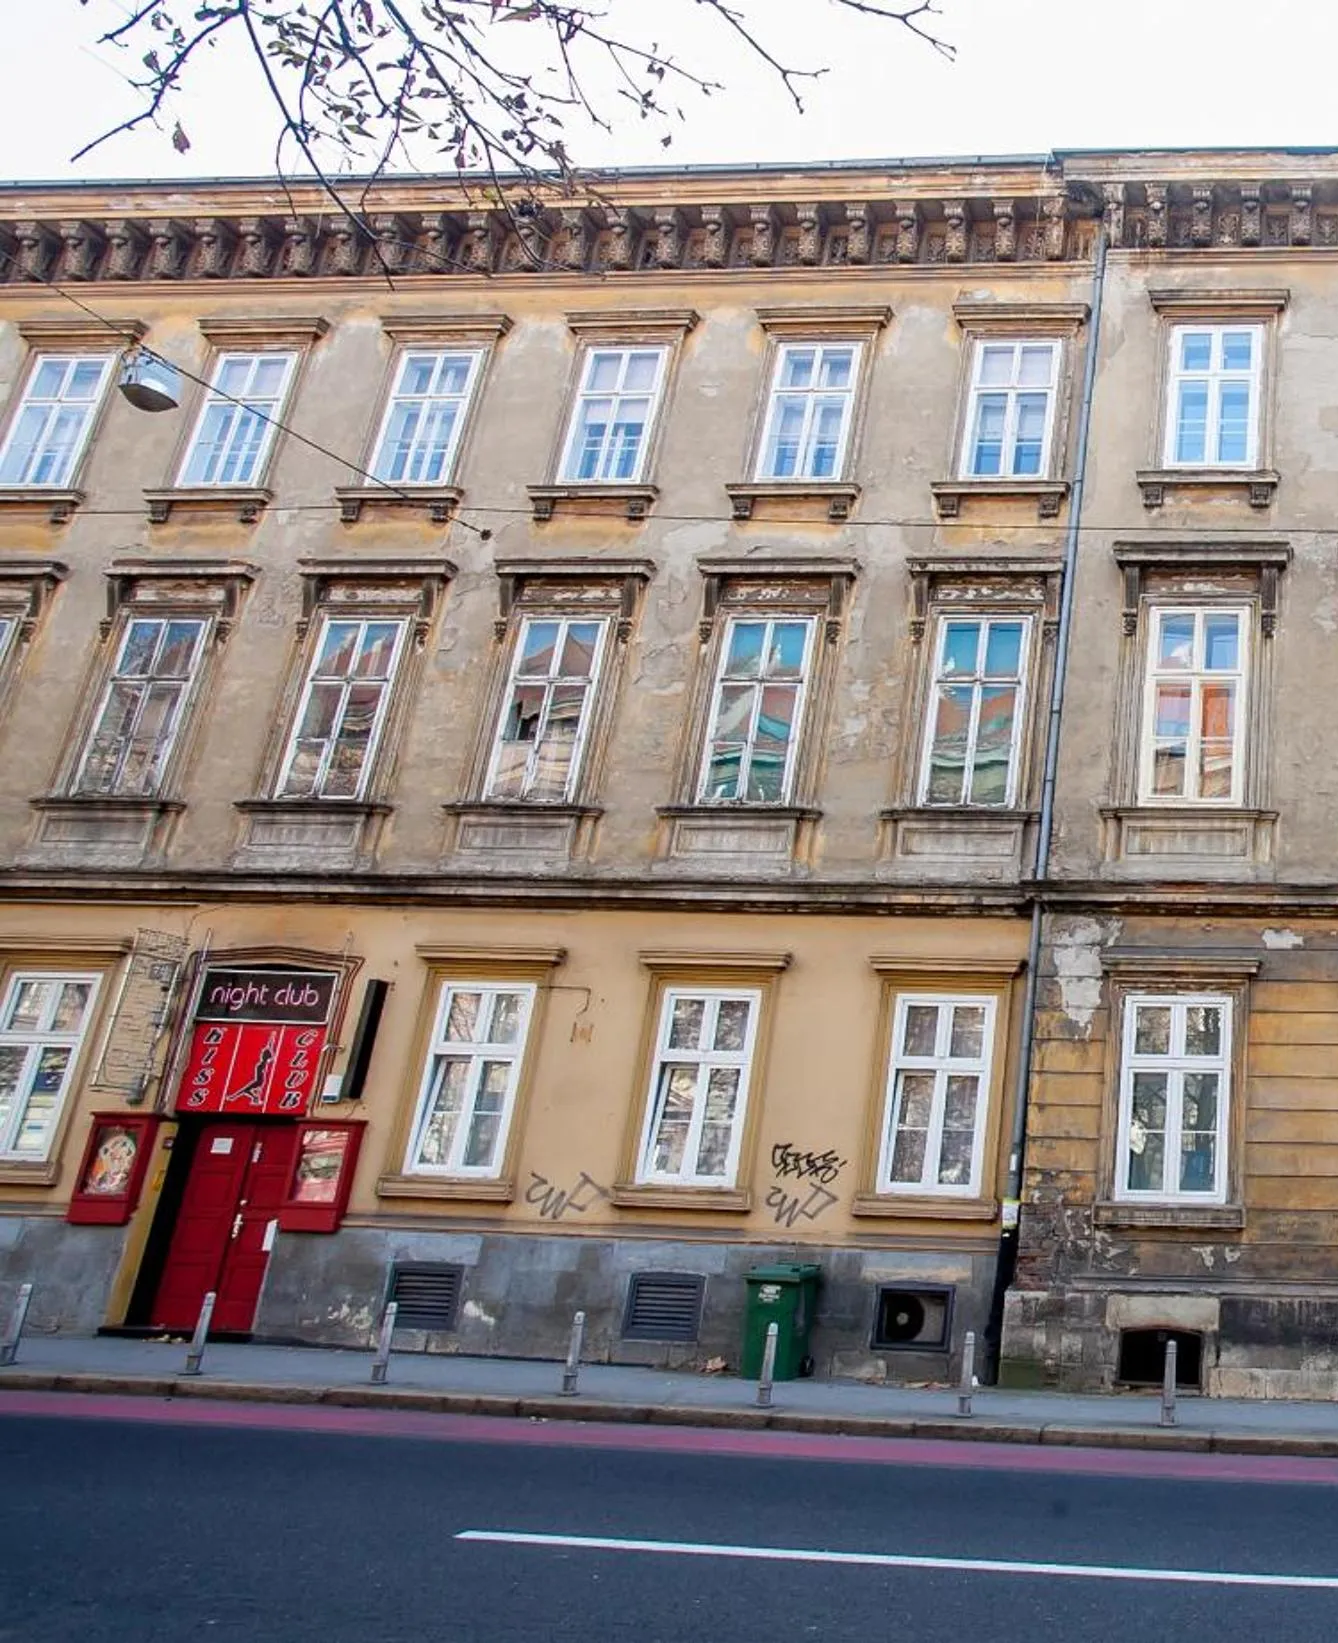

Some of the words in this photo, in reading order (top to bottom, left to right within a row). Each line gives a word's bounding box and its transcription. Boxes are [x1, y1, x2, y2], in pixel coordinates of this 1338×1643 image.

[208, 981, 271, 1011] night
[273, 982, 320, 1007] club
[186, 1026, 229, 1107] KISS
[278, 1028, 319, 1109] CLUB
